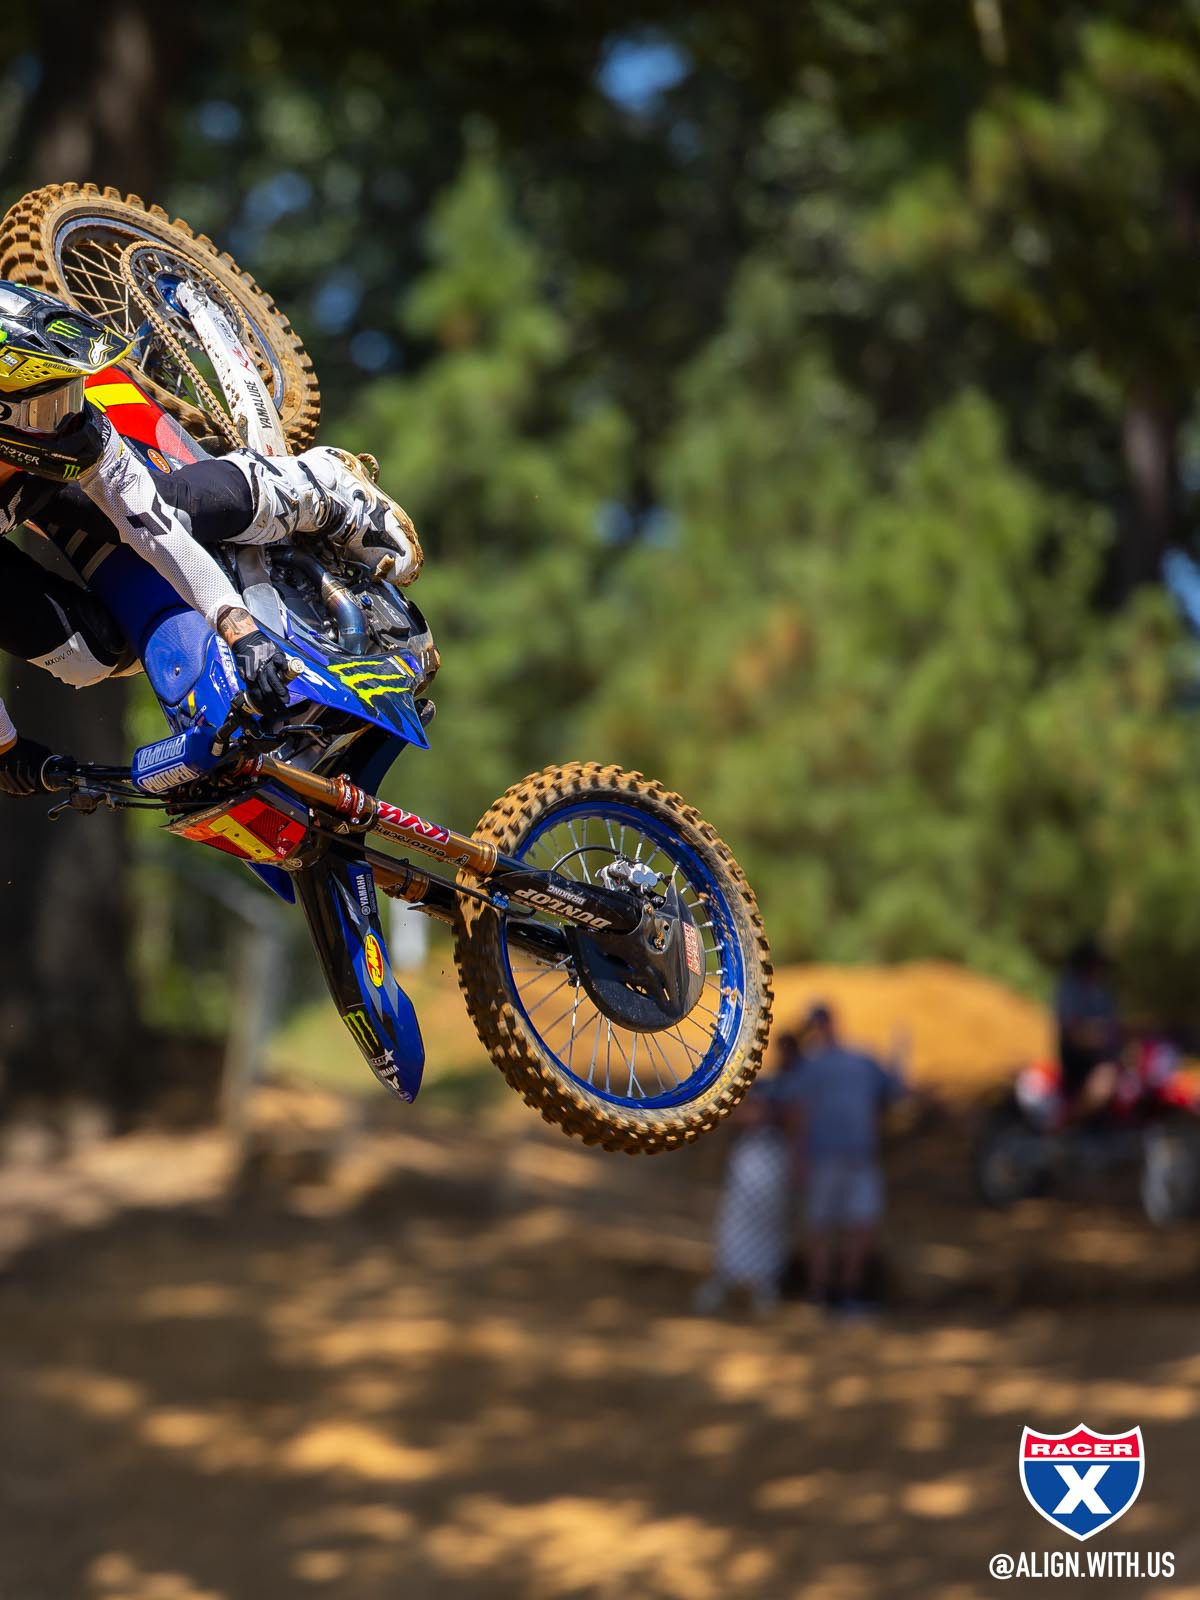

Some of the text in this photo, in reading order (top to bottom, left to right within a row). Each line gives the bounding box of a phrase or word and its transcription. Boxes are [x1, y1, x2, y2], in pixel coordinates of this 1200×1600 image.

[244, 380, 273, 429] YAMALUBE
[356, 873, 368, 905] YAMAHA
[514, 888, 612, 929] DUNLOP
[547, 884, 586, 905] BRAKING
[365, 935, 383, 985] FMF
